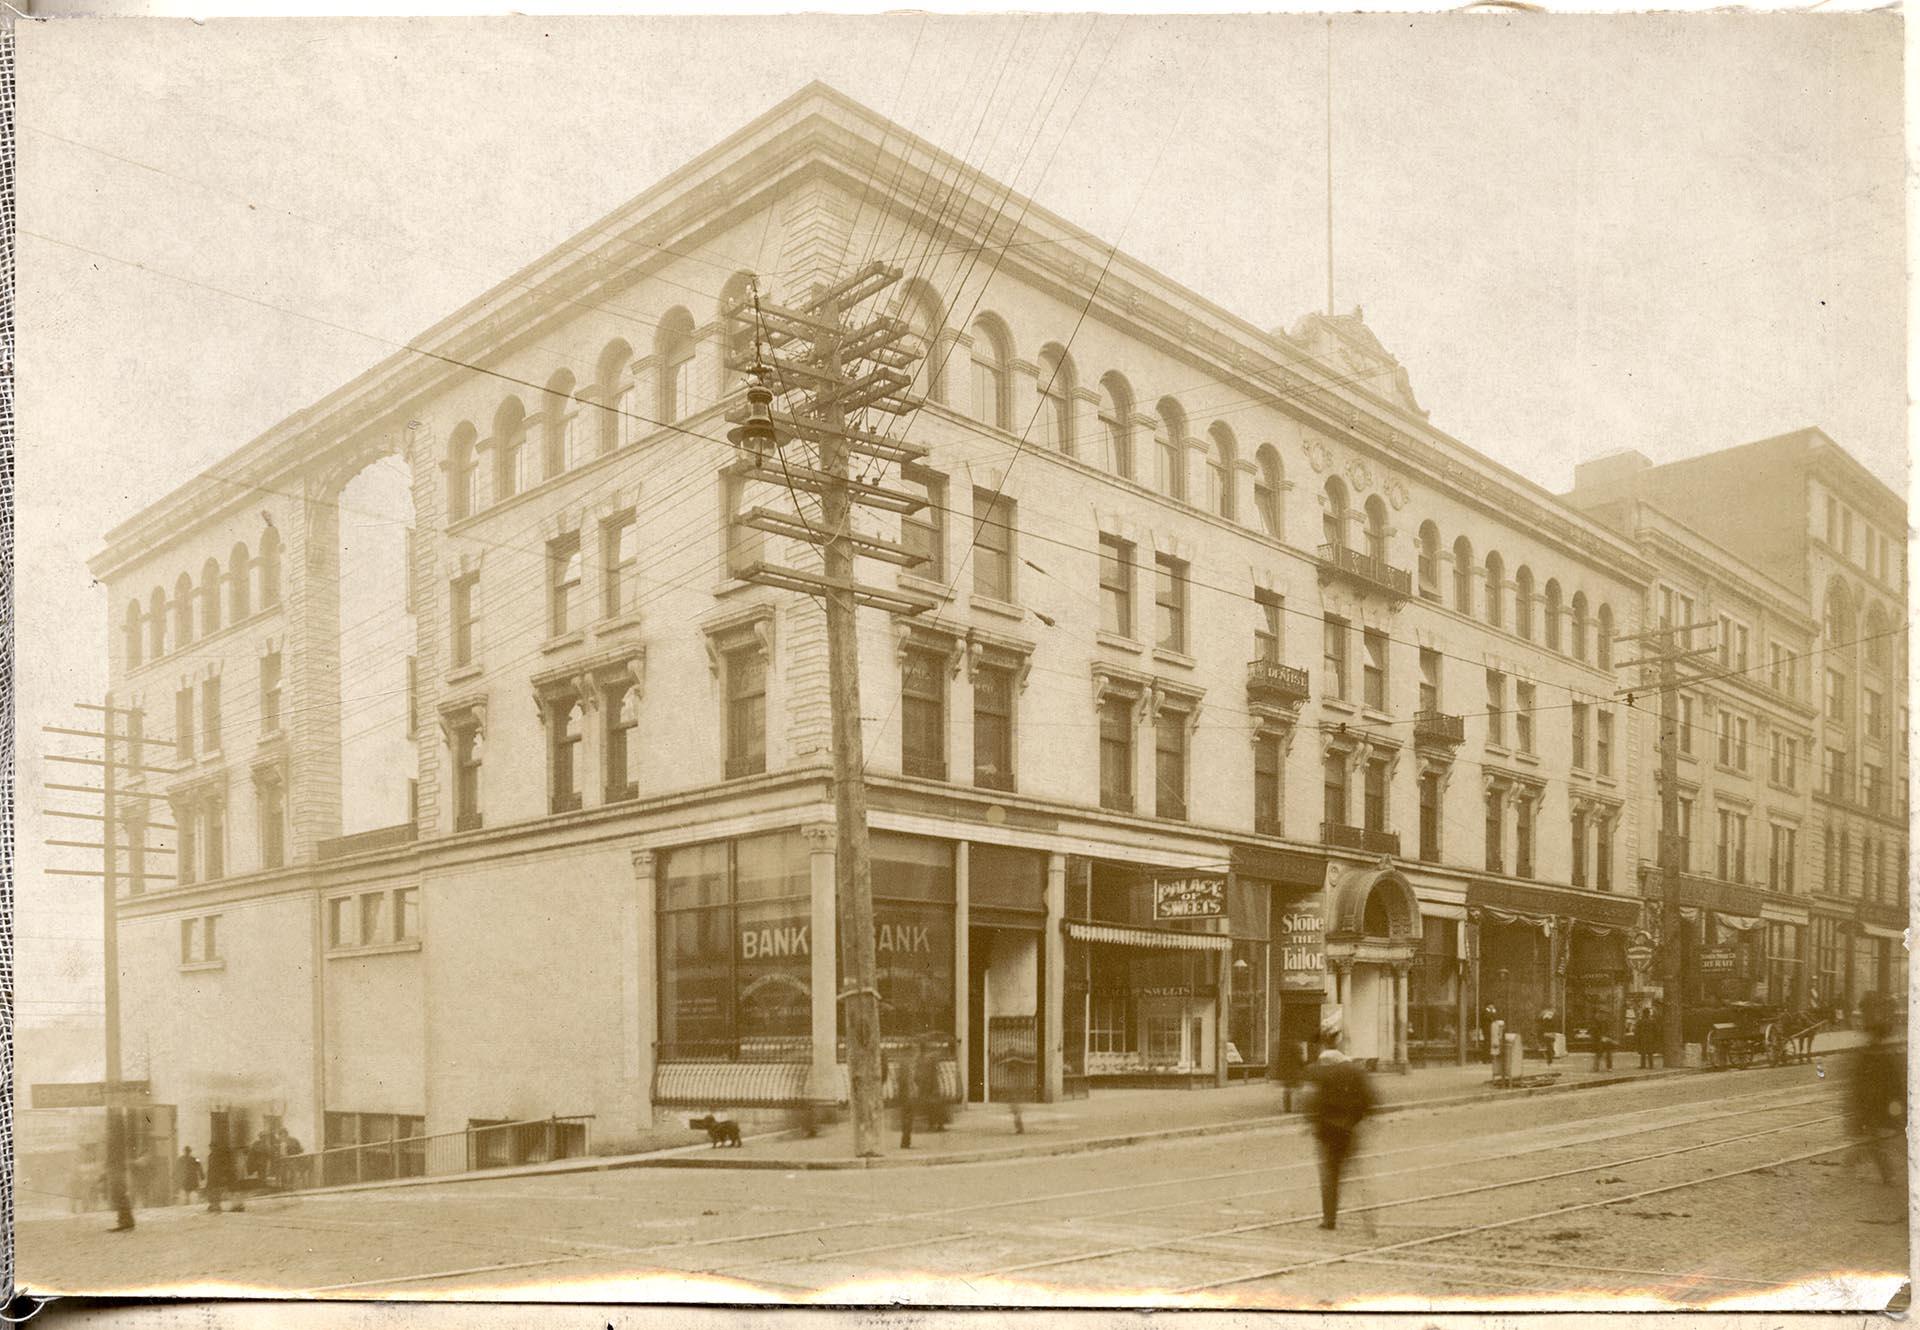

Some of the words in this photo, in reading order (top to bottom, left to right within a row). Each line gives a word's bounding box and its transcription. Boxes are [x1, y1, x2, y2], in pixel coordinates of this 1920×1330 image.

[1158, 879, 1225, 903] PALACE
[1160, 900, 1221, 916] SWEETS
[1282, 913, 1325, 934] Stone
[742, 925, 809, 959] BANK
[874, 924, 930, 952] ANK
[1281, 947, 1324, 970] Tailor
